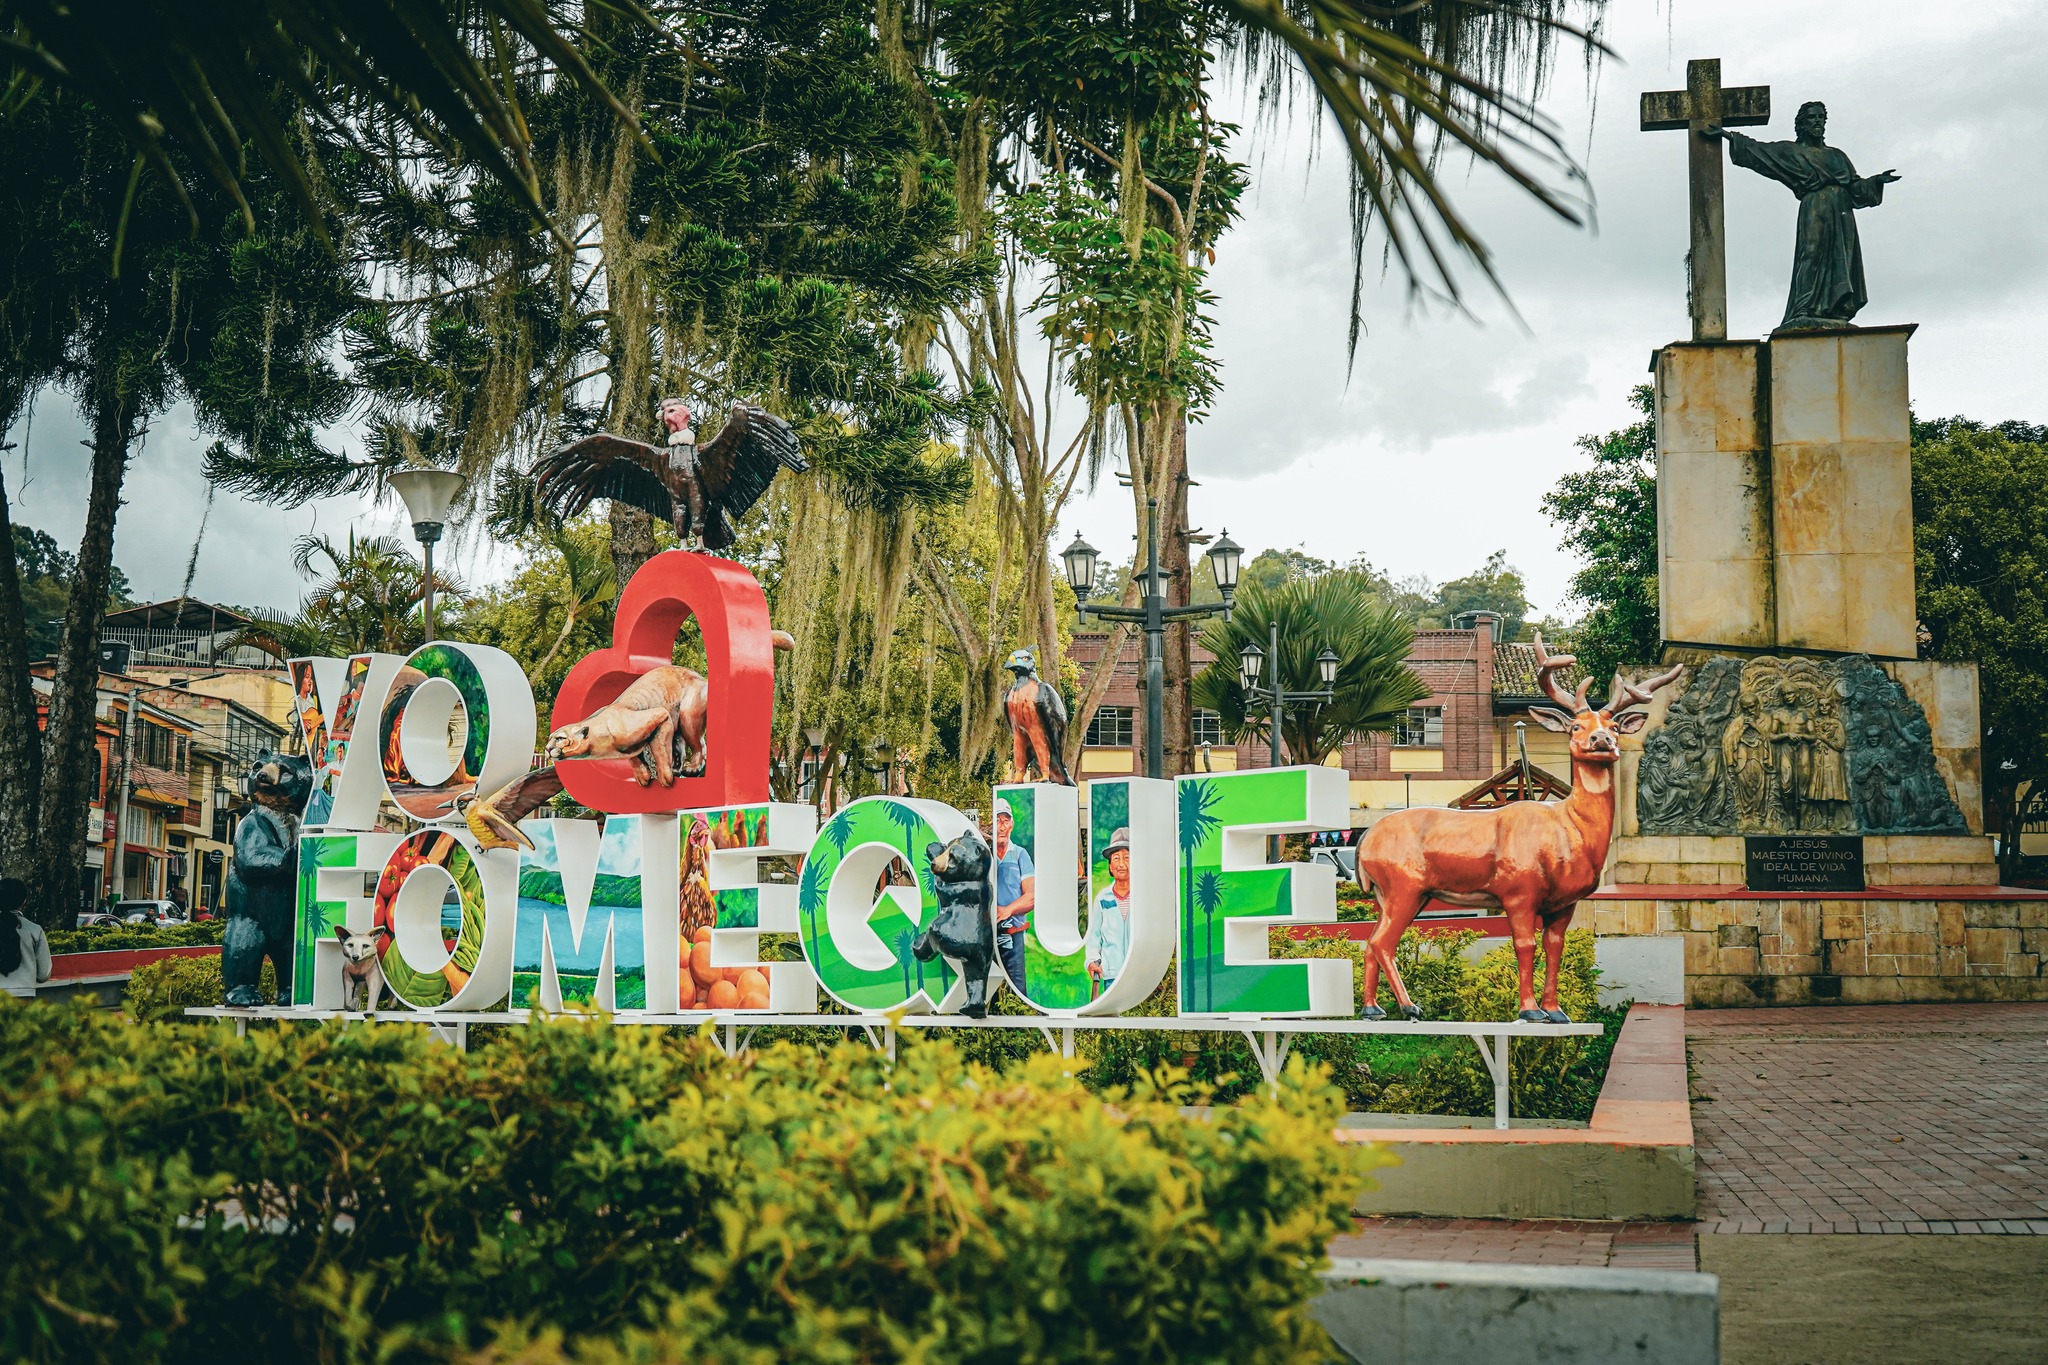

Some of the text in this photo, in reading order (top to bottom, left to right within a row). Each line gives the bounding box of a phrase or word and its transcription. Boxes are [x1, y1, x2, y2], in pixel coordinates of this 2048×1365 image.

[287, 641, 536, 832] YO
[1779, 840, 1788, 849] A
[1752, 851, 1810, 860] MAESTRO
[1763, 862, 1846, 872] IDEAL DE VIDA
[291, 764, 1355, 1021] FOMEQUE
